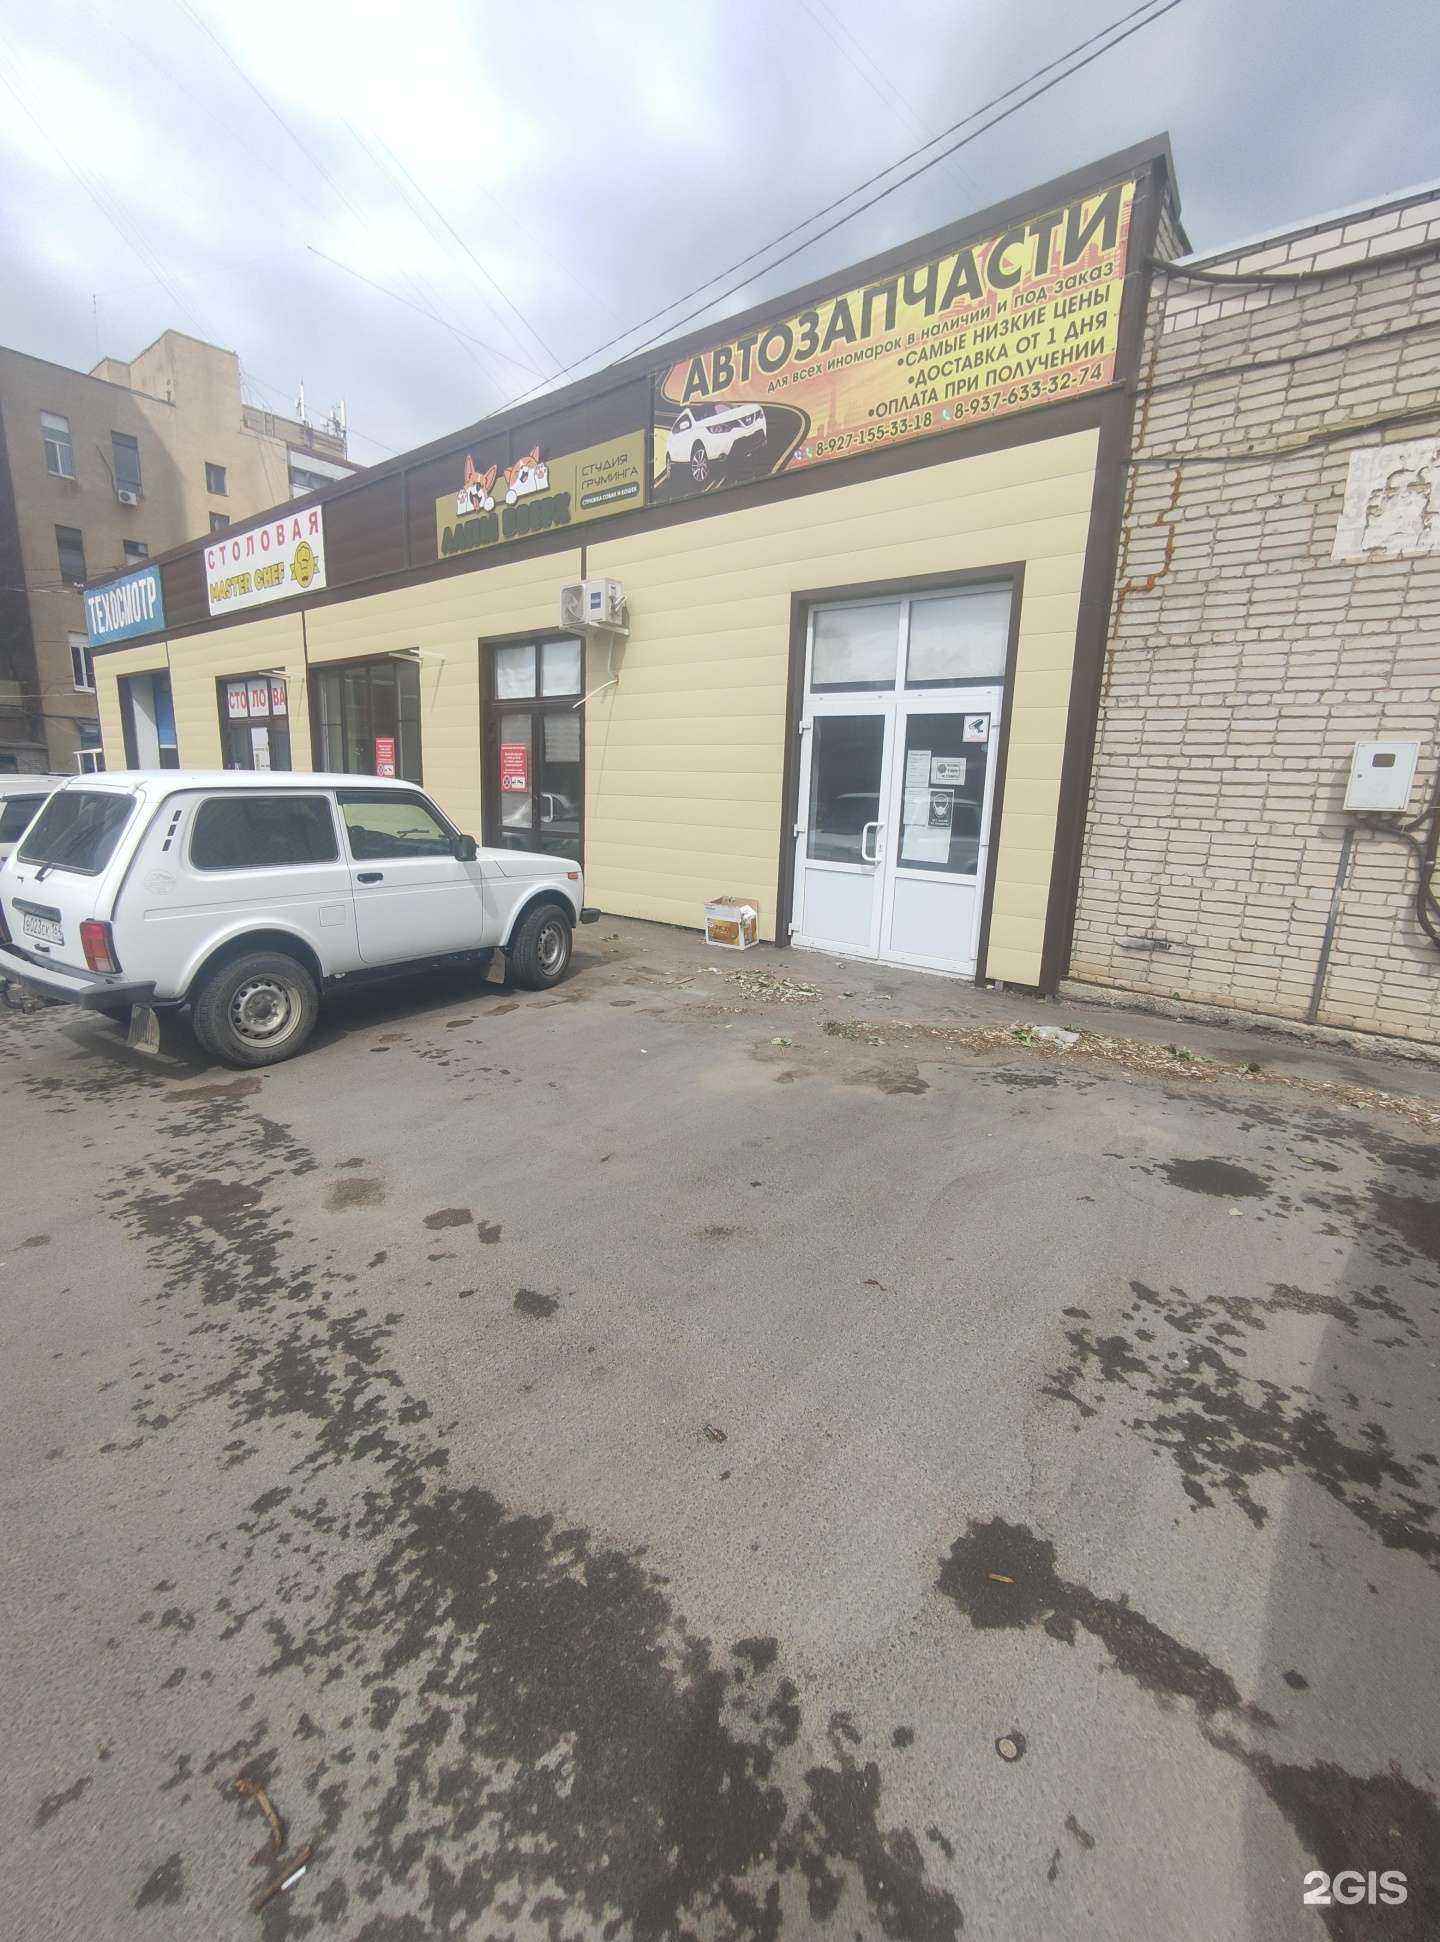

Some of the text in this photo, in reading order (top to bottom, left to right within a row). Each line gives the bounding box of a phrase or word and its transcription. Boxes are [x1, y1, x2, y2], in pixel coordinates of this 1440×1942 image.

[681, 188, 1125, 403] АВТОЗАПЧАСТИ
[767, 262, 1114, 394] для всех иномарок в наличии и под заказ
[905, 284, 1111, 367] САМЫЕ НИЗКИЕ ЦЕНЫ
[914, 310, 1108, 389] ДОСТАВКА ОТ 1 ДНЯ
[875, 336, 1106, 419] ОПЛАТА ПРИ ПОЛУЧЕНИИ
[953, 366, 1102, 420] 8-937-633-32-74
[816, 412, 933, 457] 8-927-155-33-18
[580, 465, 640, 490] ГРУМИНГА
[581, 453, 629, 477] СТУДИЯ
[207, 511, 319, 570] СТОЛОВАЯ
[88, 576, 157, 635] ТЕХОСМОТР
[209, 561, 285, 603] MASTER CHEF
